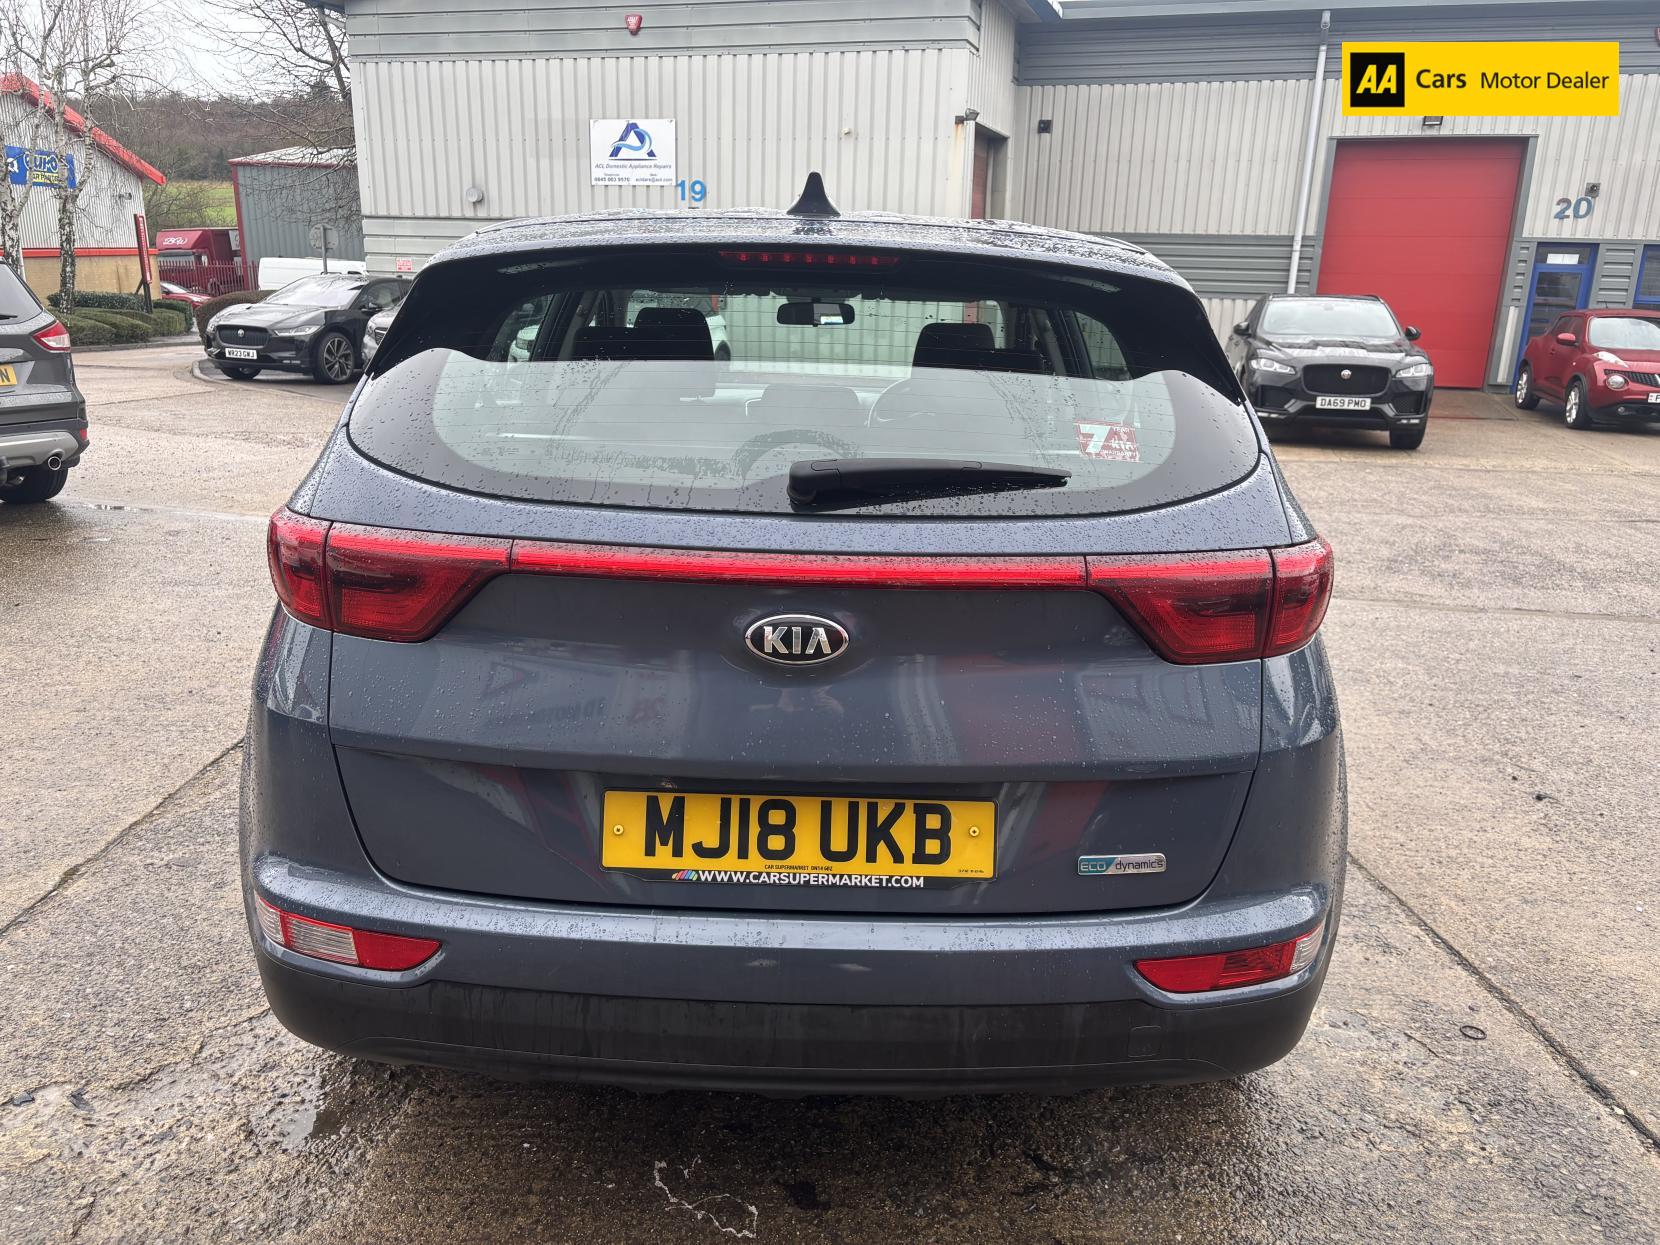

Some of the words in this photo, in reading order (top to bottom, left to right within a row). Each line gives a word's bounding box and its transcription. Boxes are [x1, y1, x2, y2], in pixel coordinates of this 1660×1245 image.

[676, 179, 706, 202] 19
[1553, 197, 1593, 220] 20
[1320, 398, 1345, 407] DA69
[1079, 424, 1112, 453] 7
[764, 626, 832, 655] KIA
[644, 795, 797, 861] MJ18
[819, 800, 952, 865] UKB
[1080, 861, 1106, 871] ECO
[1115, 860, 1164, 872] dynamics
[699, 870, 924, 888] WWW.CARSUPERMARKET.COM
